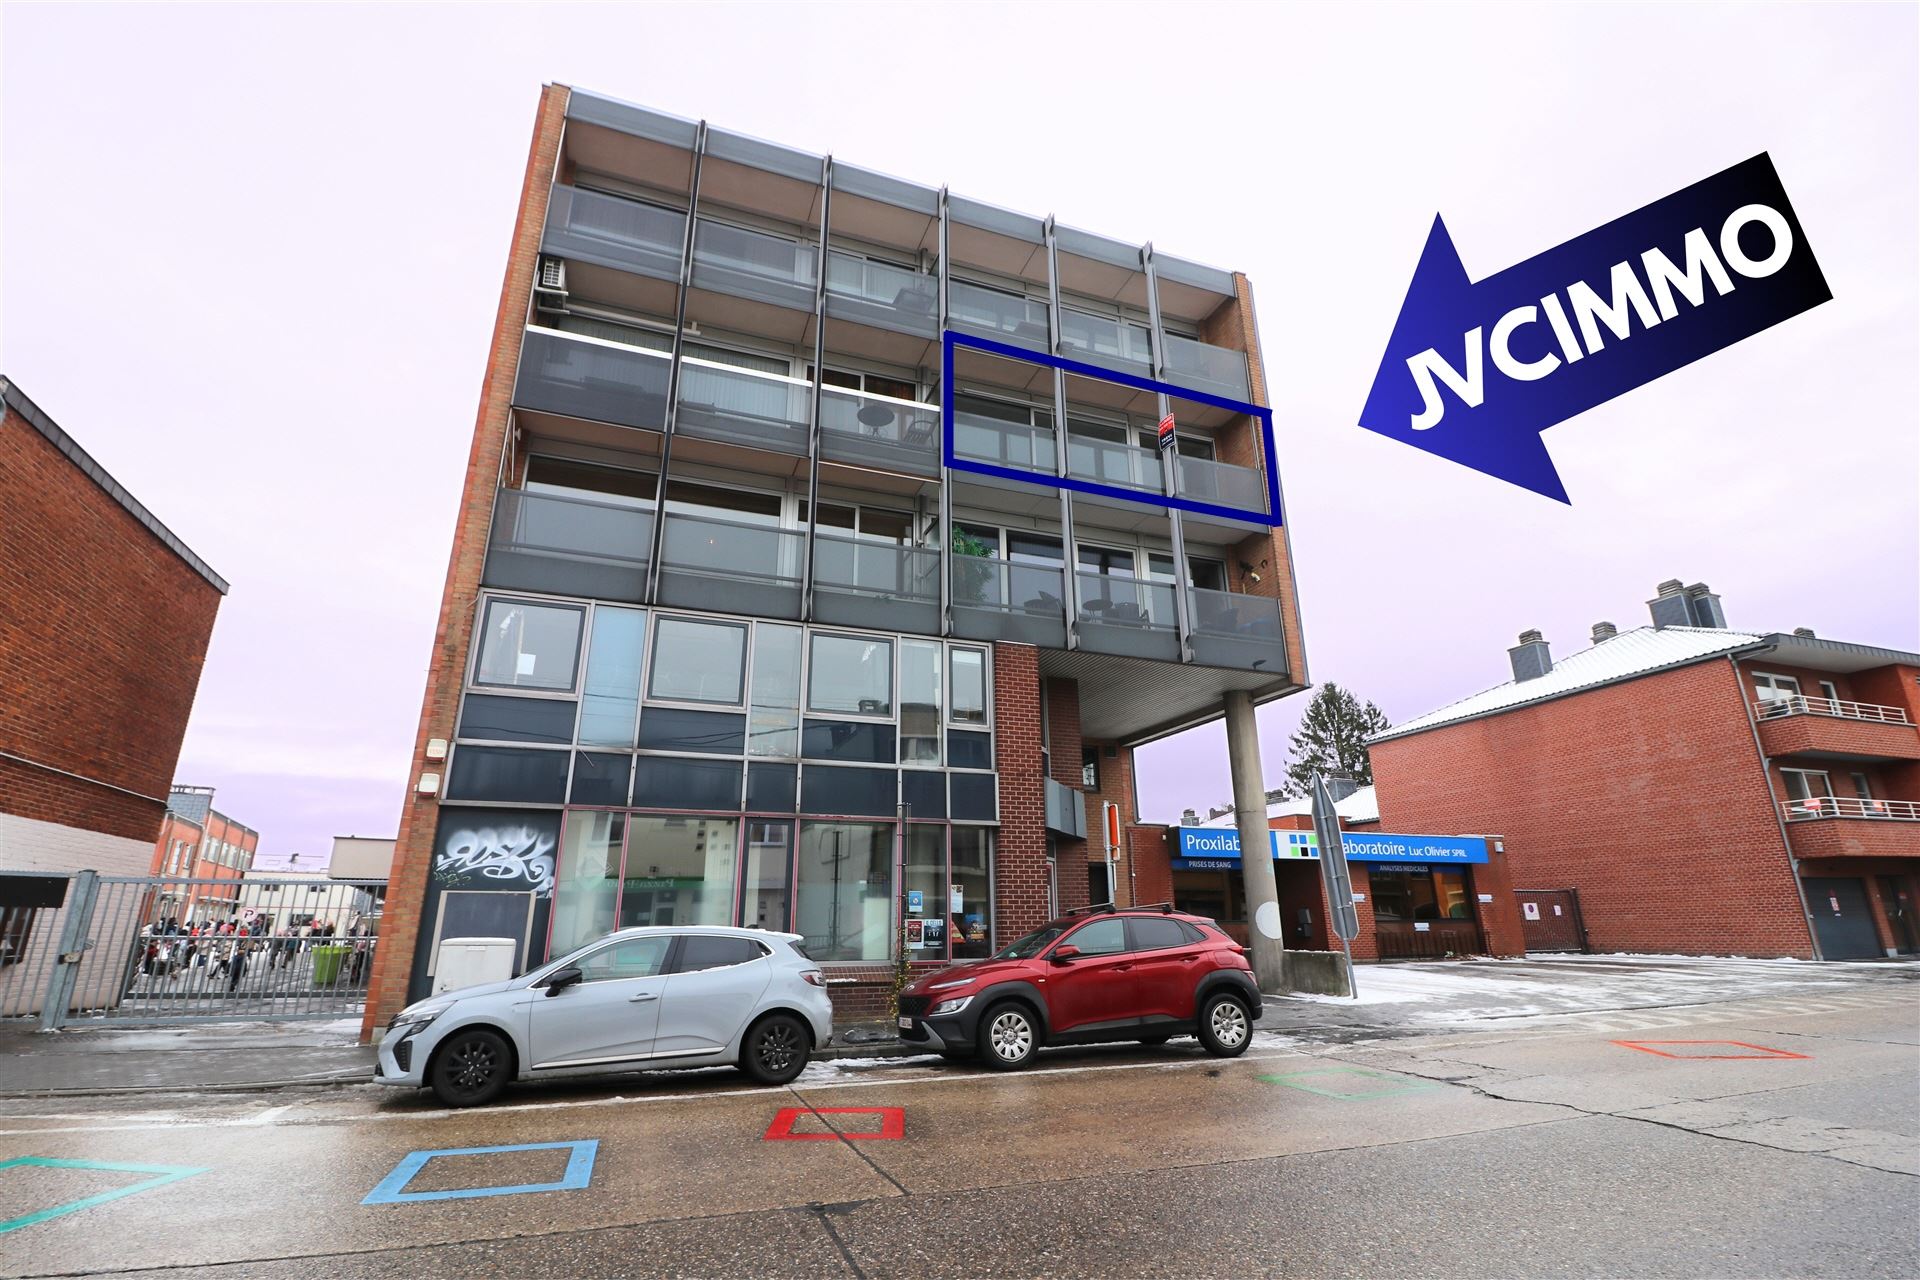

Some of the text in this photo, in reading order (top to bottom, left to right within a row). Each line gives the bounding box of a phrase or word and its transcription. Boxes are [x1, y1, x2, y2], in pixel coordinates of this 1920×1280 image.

[1186, 834, 1240, 851] Proxilab
[1343, 839, 1406, 856] aboratoire
[1408, 846, 1424, 857] Luc
[1424, 846, 1451, 857] Olivier
